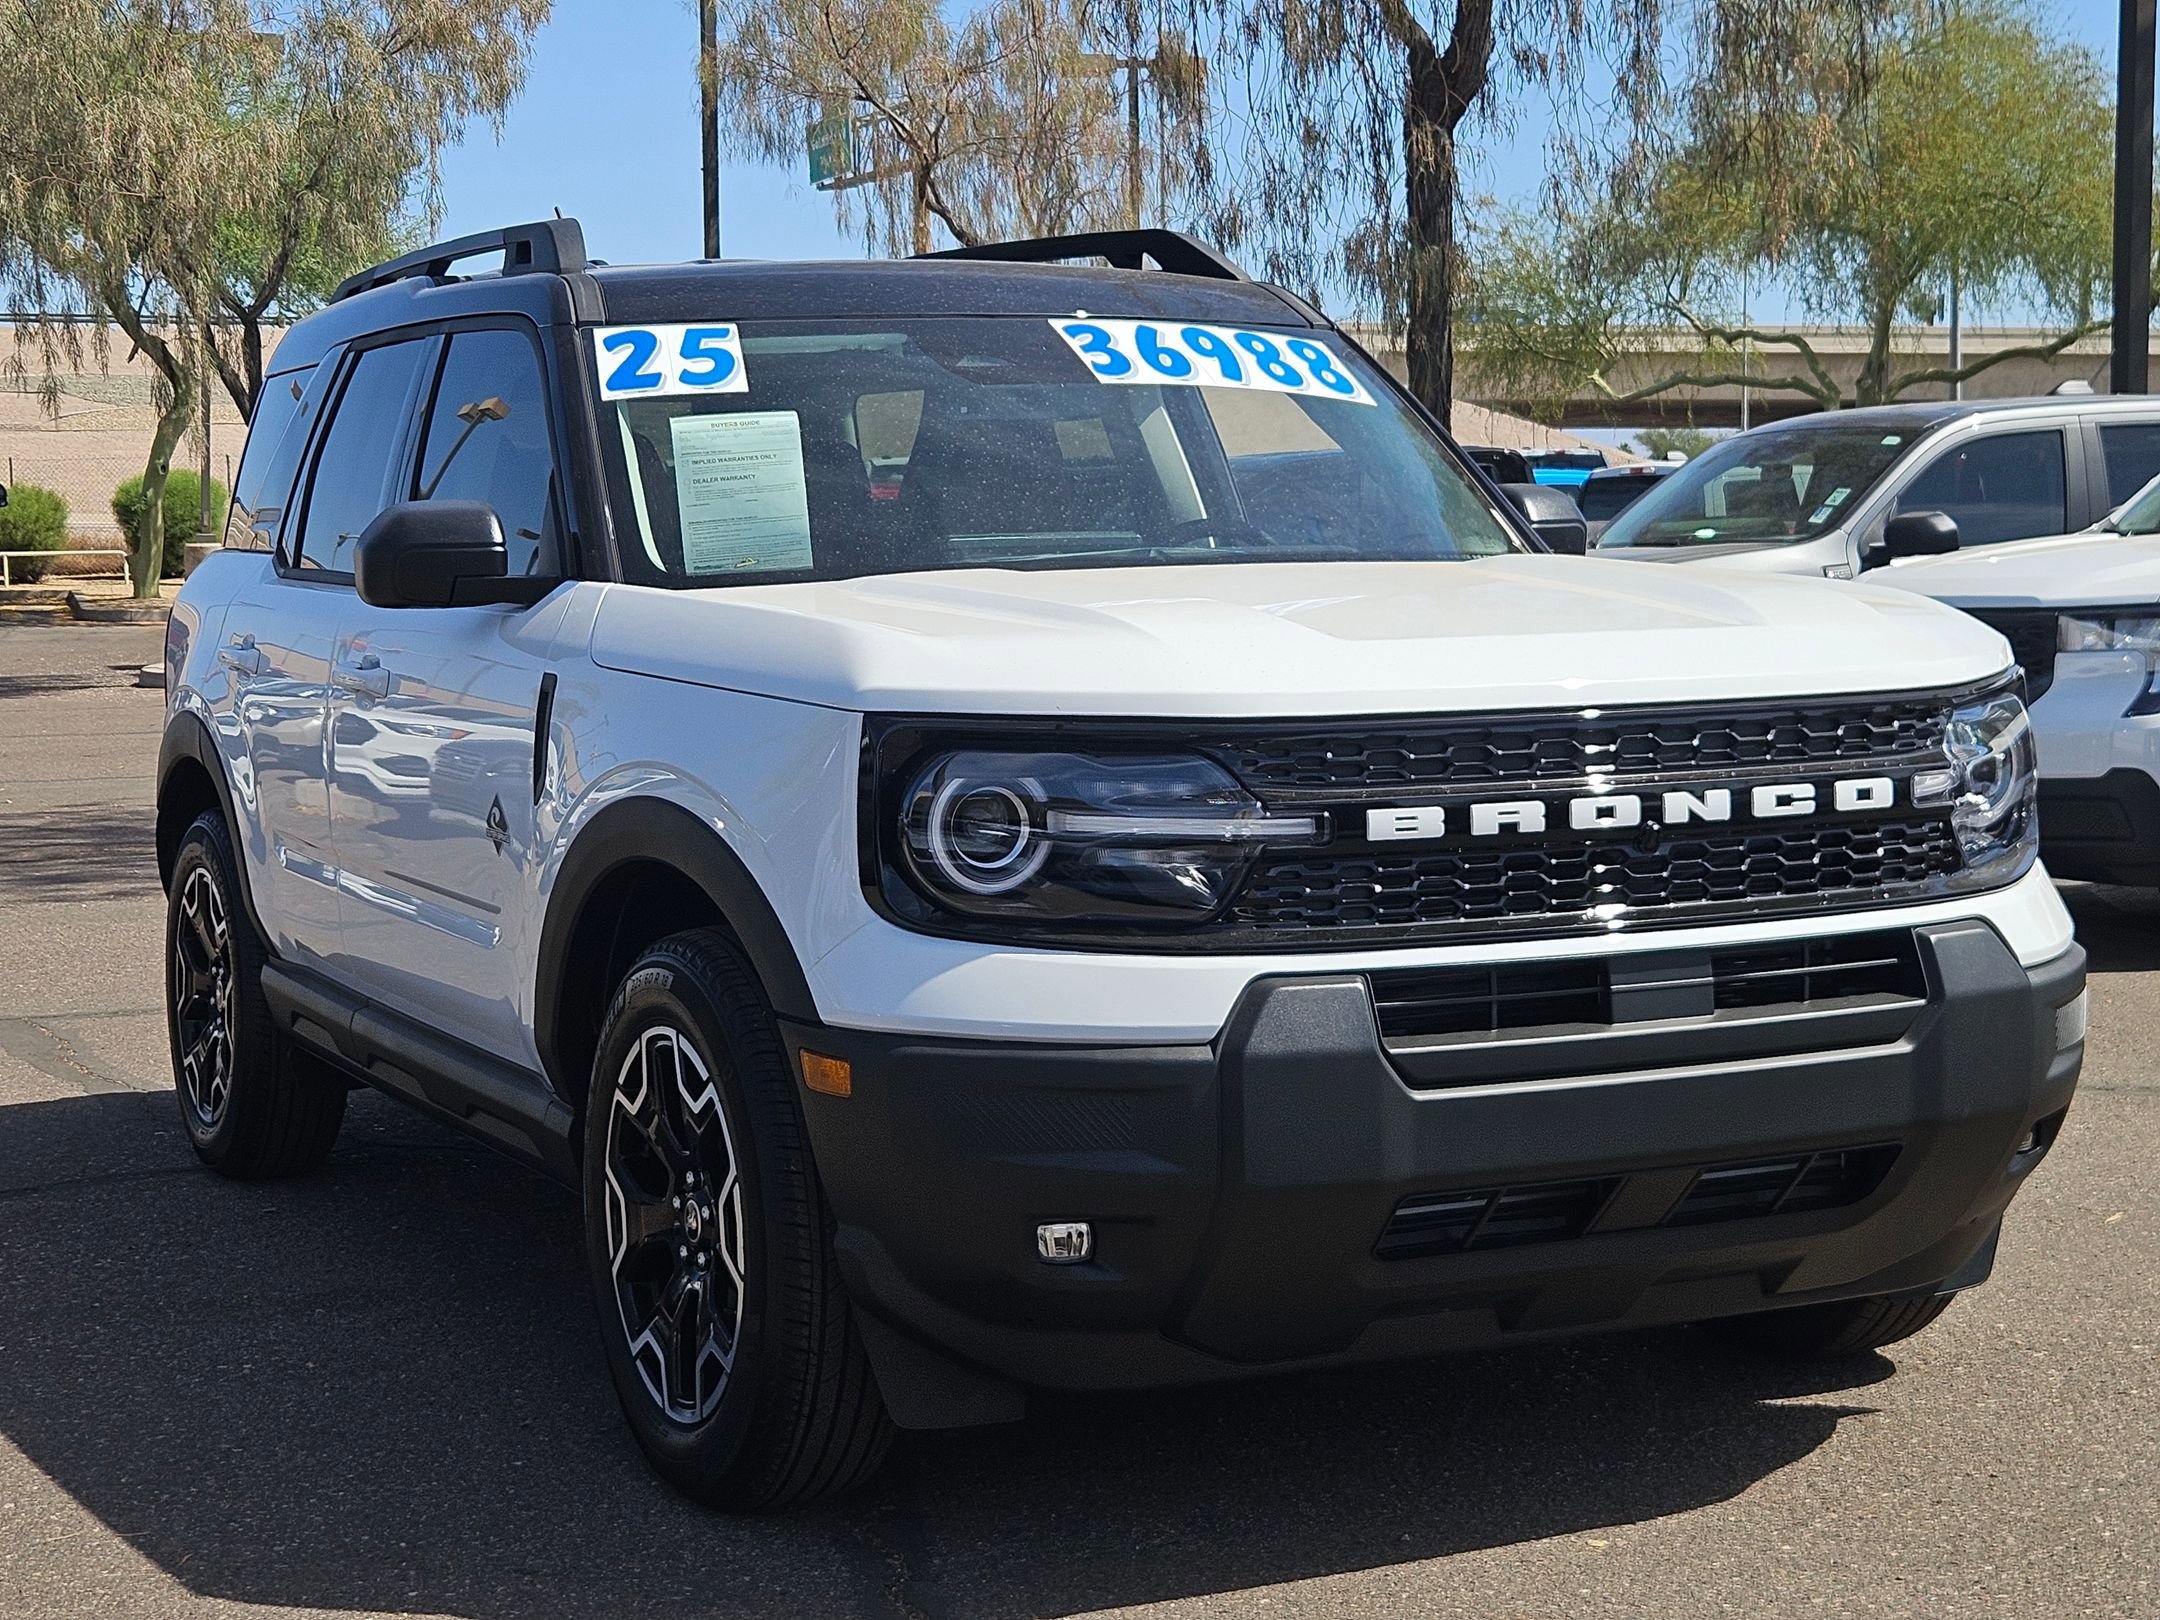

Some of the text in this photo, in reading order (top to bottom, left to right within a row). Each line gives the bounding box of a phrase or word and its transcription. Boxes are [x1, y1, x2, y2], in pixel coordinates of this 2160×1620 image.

[603, 326, 736, 390] 25
[1063, 323, 1355, 395] 36988
[692, 474, 756, 485] DEALER WARRANTY
[718, 455, 759, 463] WARRANTIES
[1366, 777, 1893, 841] BRONCO
